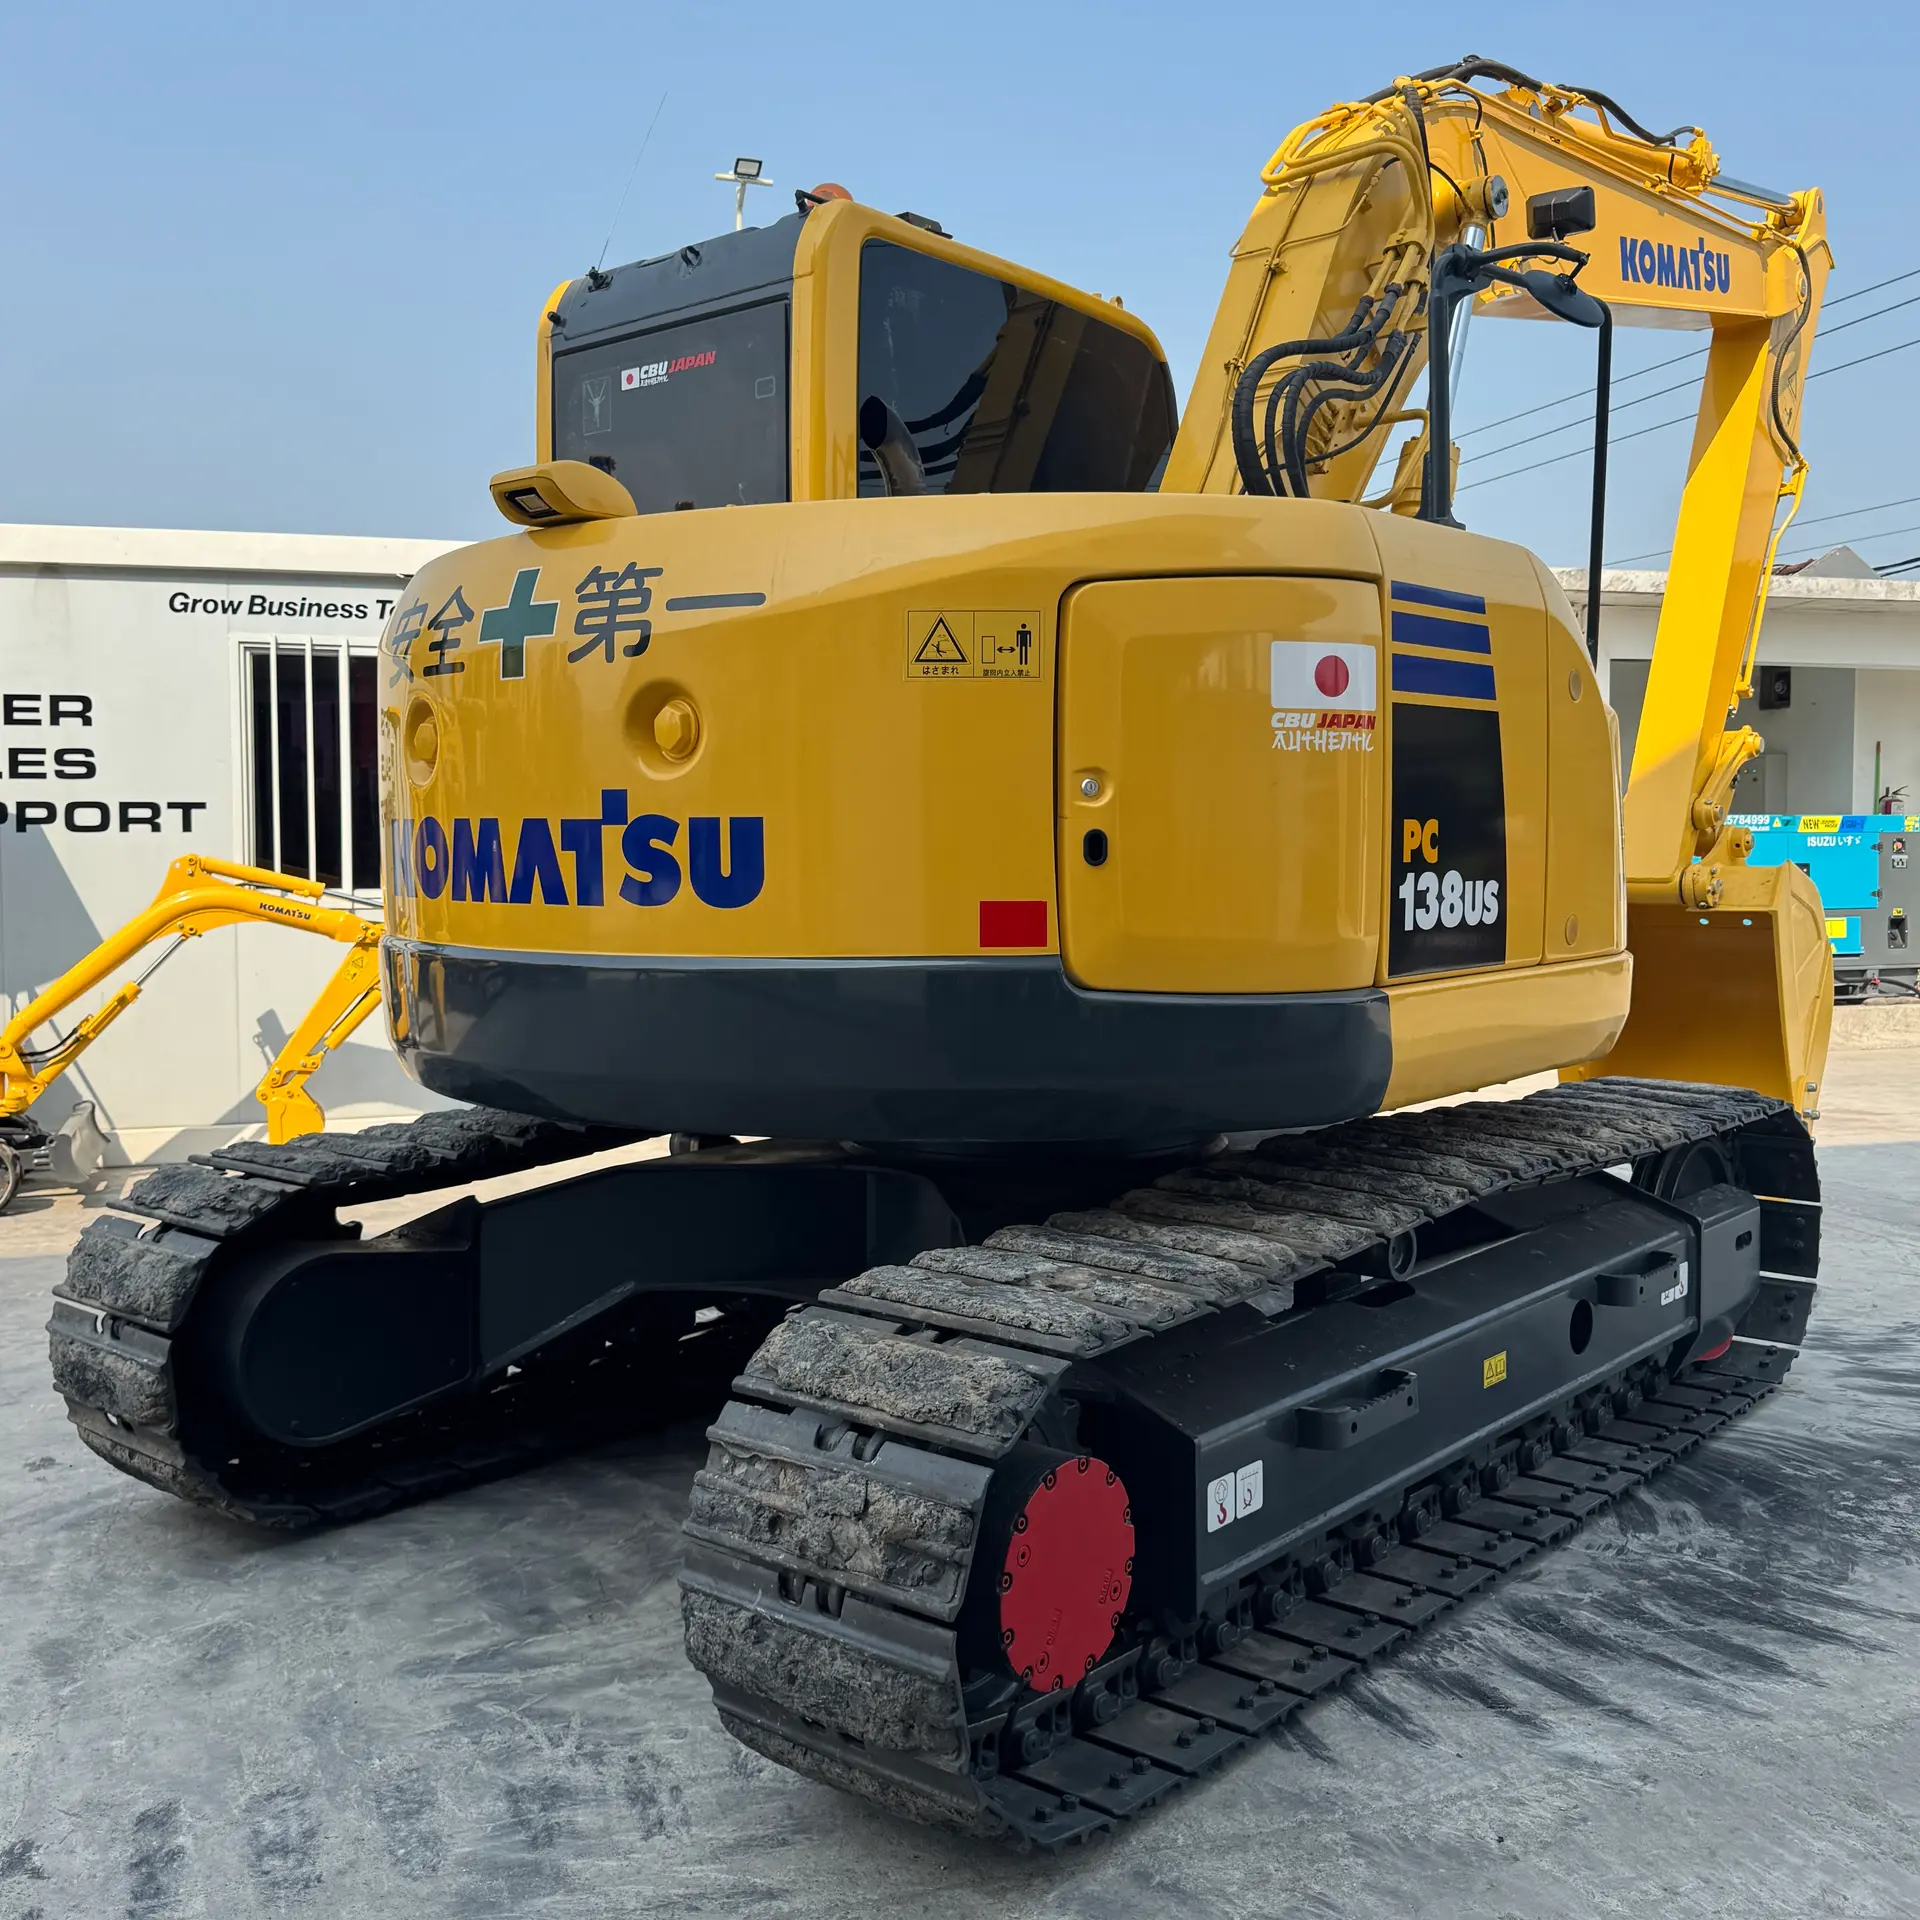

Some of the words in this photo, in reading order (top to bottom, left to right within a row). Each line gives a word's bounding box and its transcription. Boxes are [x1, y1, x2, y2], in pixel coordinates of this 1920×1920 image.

[1620, 236, 1730, 294] KOMATSU
[640, 361, 669, 380] CBU
[668, 351, 716, 375] JAPAN
[169, 592, 243, 614] Grow
[248, 595, 369, 619] Business
[376, 599, 396, 619] T
[390, 585, 475, 689] 安全
[567, 561, 767, 664] 第一
[922, 666, 959, 676] はさまれ
[3, 694, 93, 726] ER
[1271, 711, 1316, 729] CBU
[1316, 712, 1376, 730] JAPAN
[0, 747, 97, 779] ES
[0, 801, 207, 832] PORT
[1724, 814, 1770, 826] 5784999
[1803, 818, 1820, 829] NEW
[391, 789, 766, 909] KOMATSU
[1403, 818, 1439, 864] PC
[1807, 835, 1836, 847] ISUZU
[259, 902, 311, 920] KOMATSU
[1399, 869, 1499, 931] 138US
